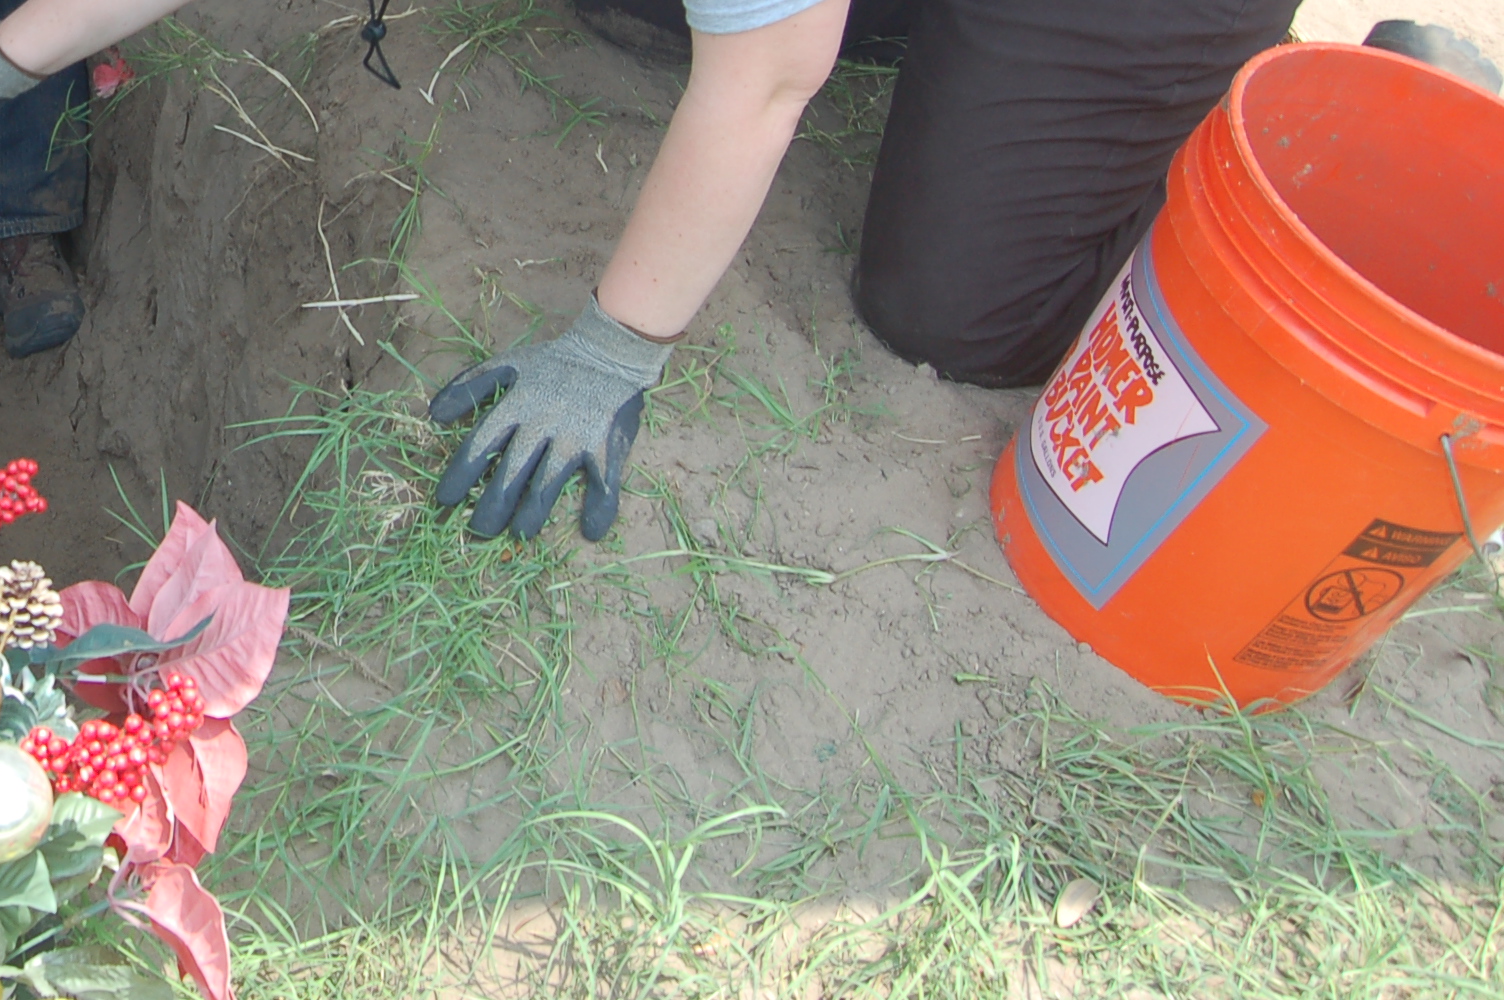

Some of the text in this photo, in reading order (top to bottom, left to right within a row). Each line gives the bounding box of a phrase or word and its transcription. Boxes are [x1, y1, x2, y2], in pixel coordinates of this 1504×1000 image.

[1067, 345, 1122, 451] PAINT
[1089, 300, 1154, 425] HOMER
[1045, 370, 1105, 493] BUCKET
